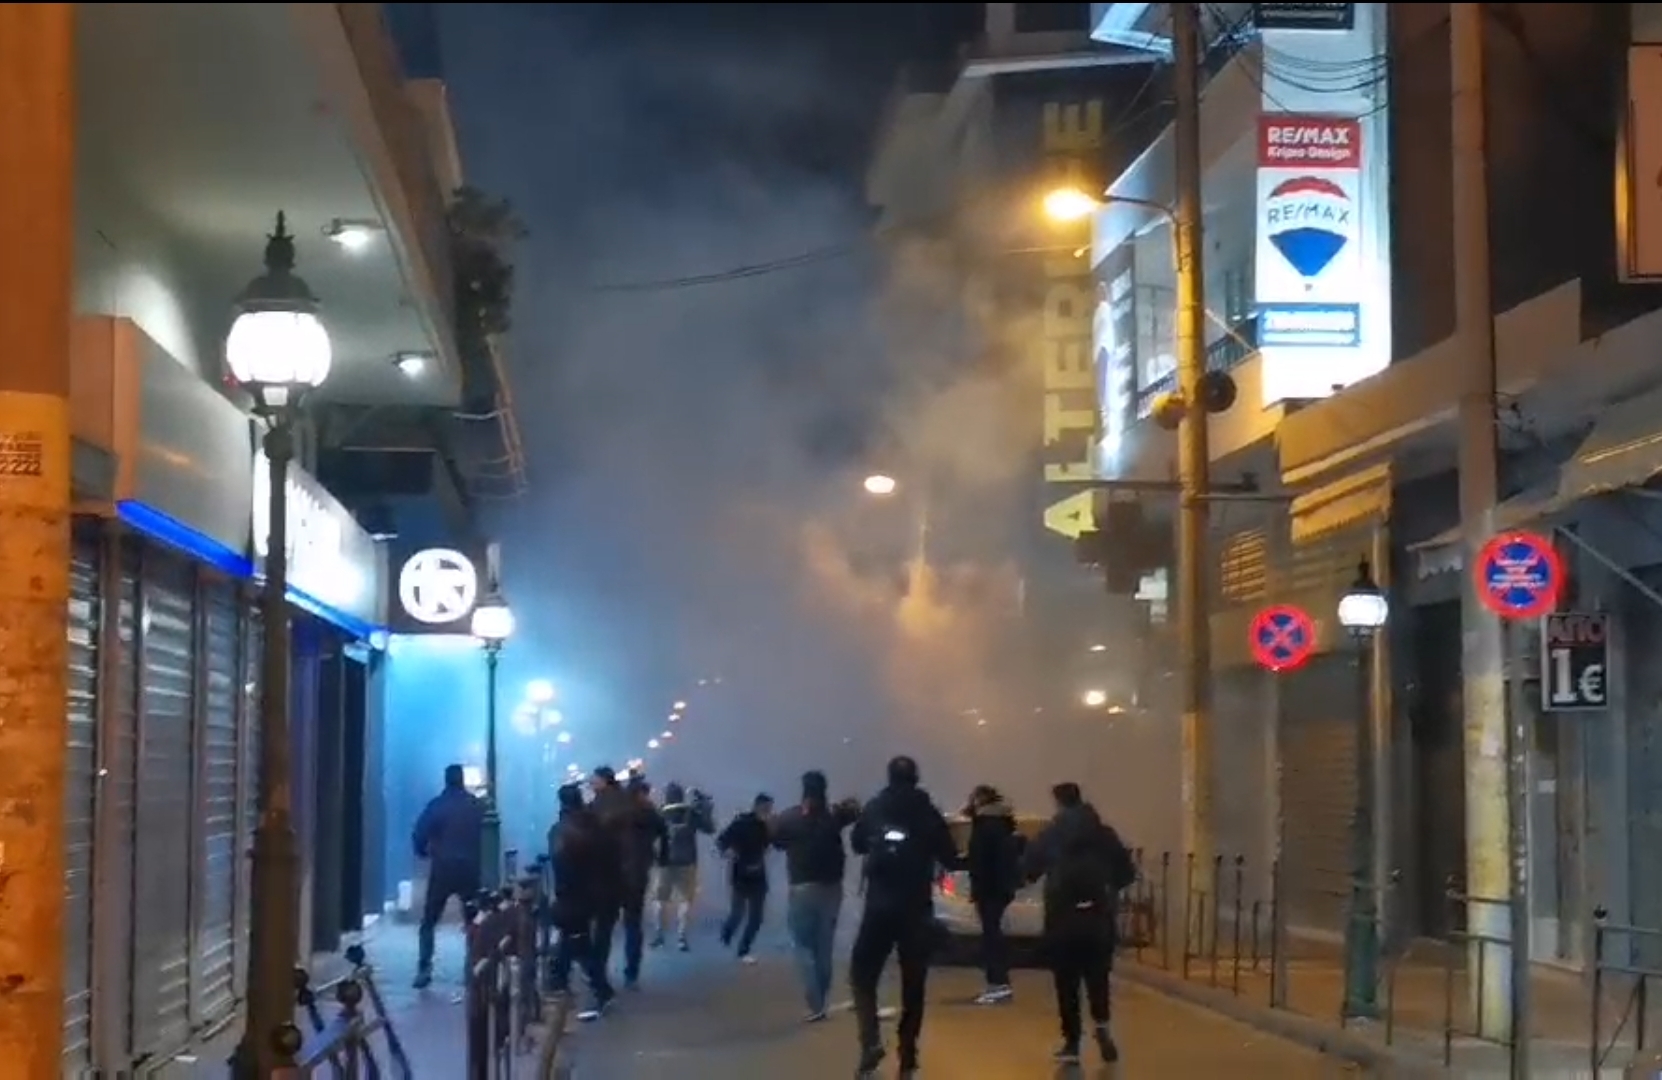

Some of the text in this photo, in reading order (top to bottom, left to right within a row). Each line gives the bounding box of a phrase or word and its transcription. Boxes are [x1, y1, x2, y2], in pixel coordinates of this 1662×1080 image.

[1267, 126, 1350, 144] RE/MAX
[1267, 203, 1350, 225] RE/MAX
[1044, 102, 1101, 540] ALTERE
